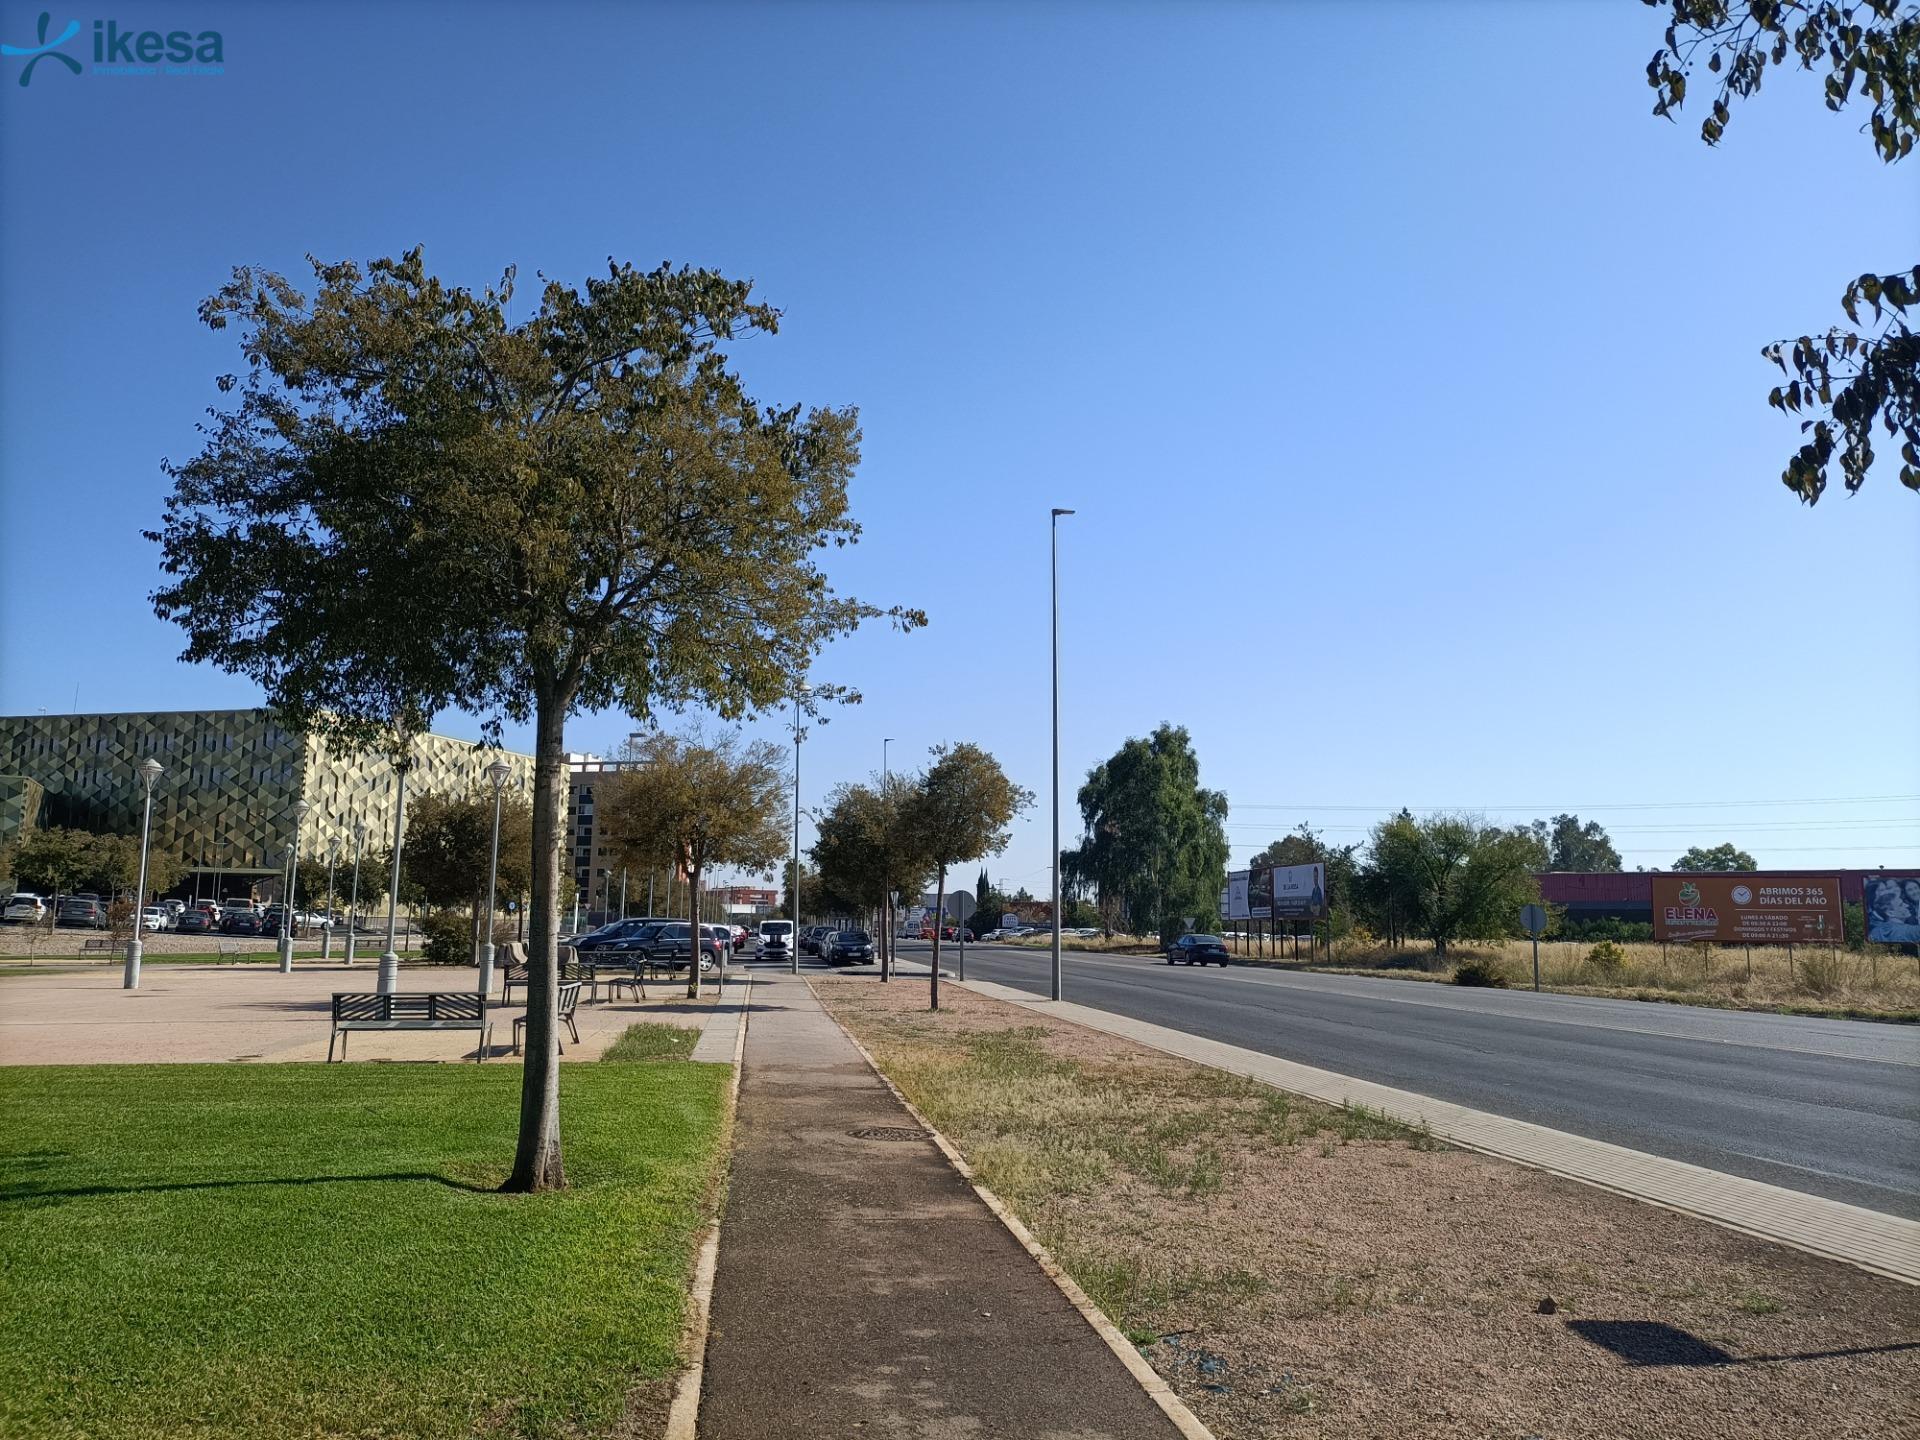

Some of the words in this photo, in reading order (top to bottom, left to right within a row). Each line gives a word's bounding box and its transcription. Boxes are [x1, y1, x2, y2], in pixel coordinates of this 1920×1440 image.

[1759, 887, 1804, 896] ABRIMOS
[1805, 887, 1824, 896] 365
[1759, 895, 1783, 905] DÍAS
[1784, 896, 1803, 905] DEL
[1805, 895, 1827, 905] AÑO
[1664, 907, 1718, 921] ELENA
